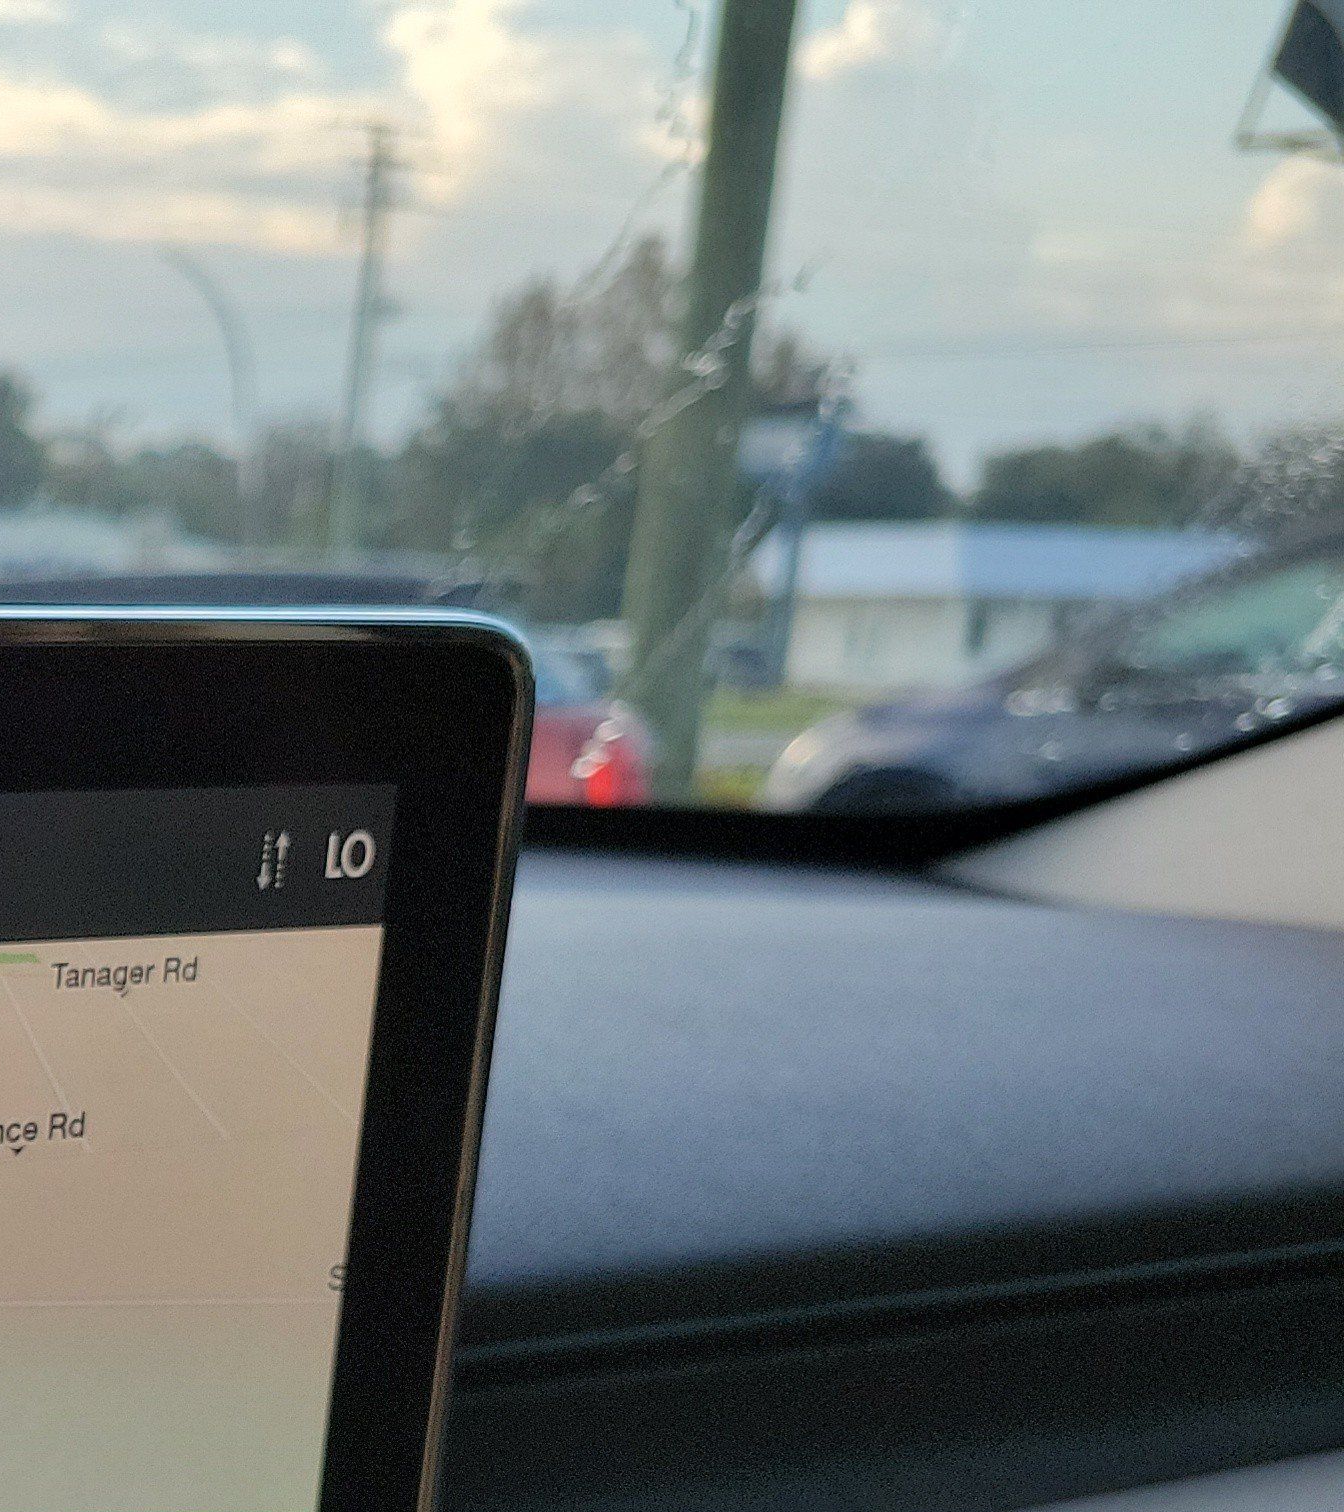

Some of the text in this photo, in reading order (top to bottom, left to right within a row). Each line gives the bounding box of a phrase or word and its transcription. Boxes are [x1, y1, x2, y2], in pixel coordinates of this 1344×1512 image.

[324, 829, 376, 879] LO
[51, 956, 199, 991] Tanager Rd
[48, 1111, 86, 1140] Rd
